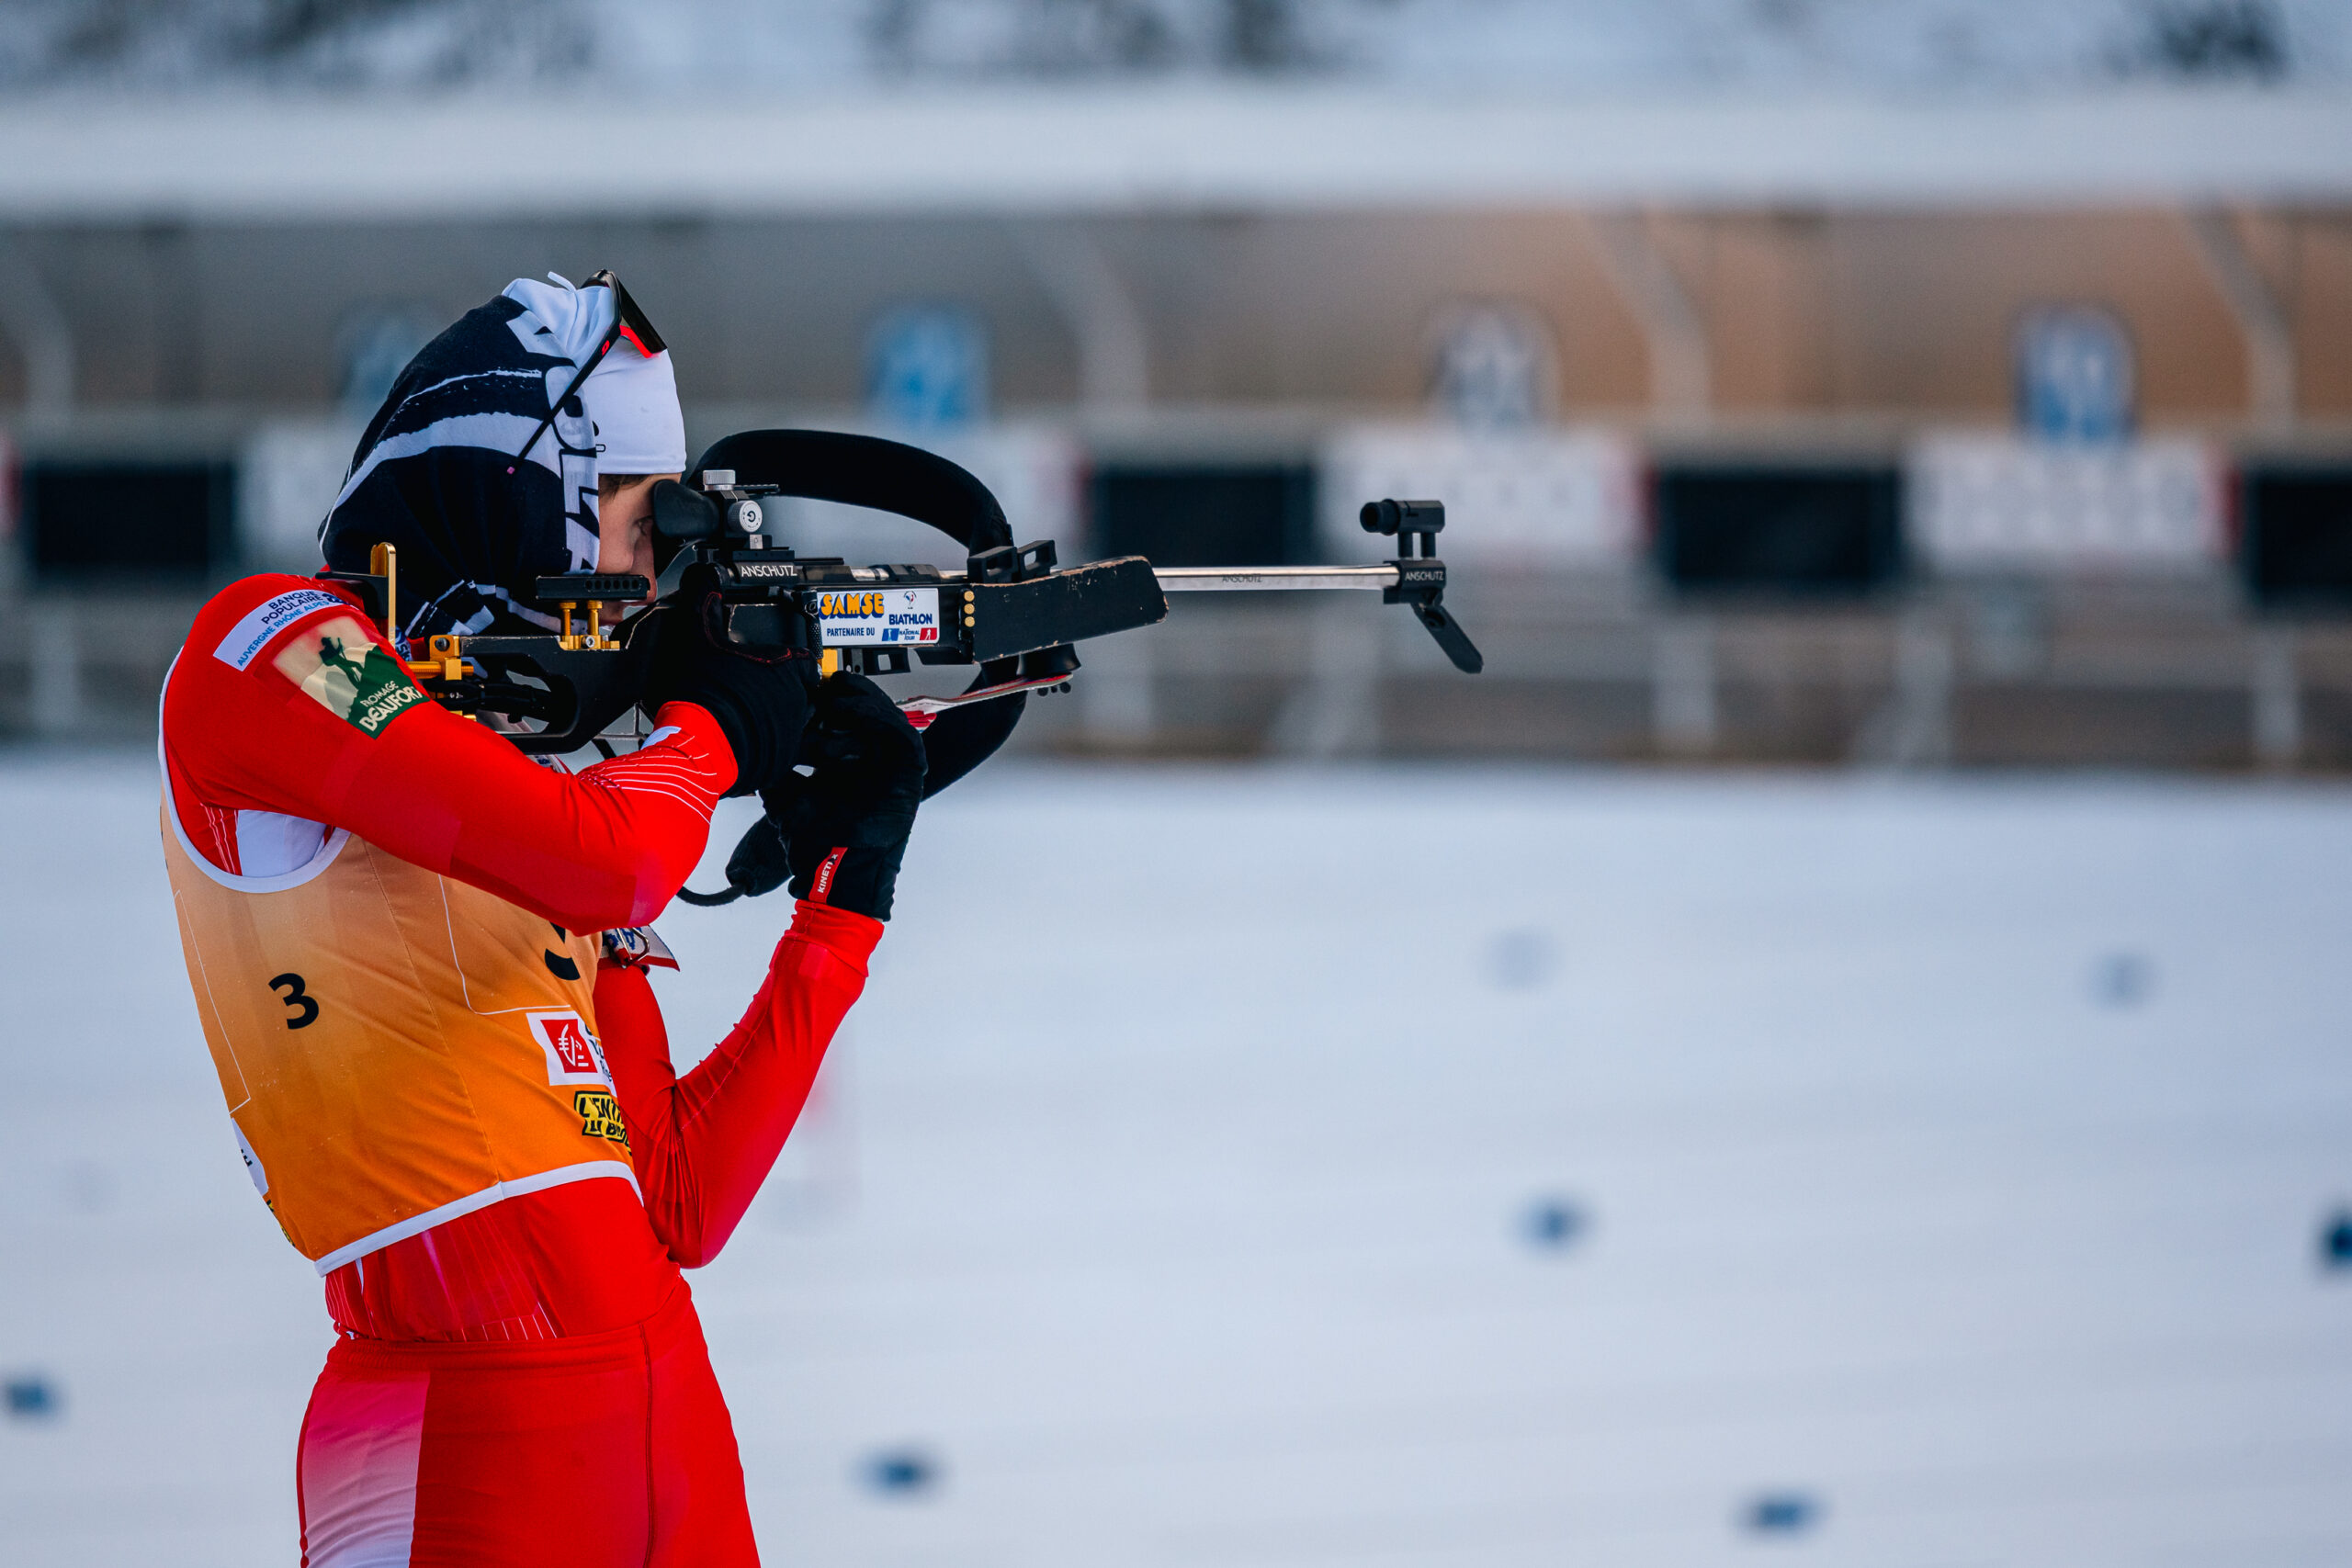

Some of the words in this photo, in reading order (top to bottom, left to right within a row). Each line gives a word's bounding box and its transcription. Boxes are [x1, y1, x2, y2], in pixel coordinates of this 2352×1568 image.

[261, 595, 323, 625] POPULAIRE
[268, 590, 318, 610] BANQUE
[819, 592, 885, 620] SAMSE
[826, 627, 865, 637] PARTENAIRE
[865, 626, 876, 637] DU
[888, 613, 933, 626] BIATHLON
[237, 626, 276, 667] AUVERGNE
[274, 608, 302, 628] RHÔNE
[302, 600, 330, 613] ALPES
[359, 680, 400, 707] FROMAGE
[267, 972, 319, 1030] 3
